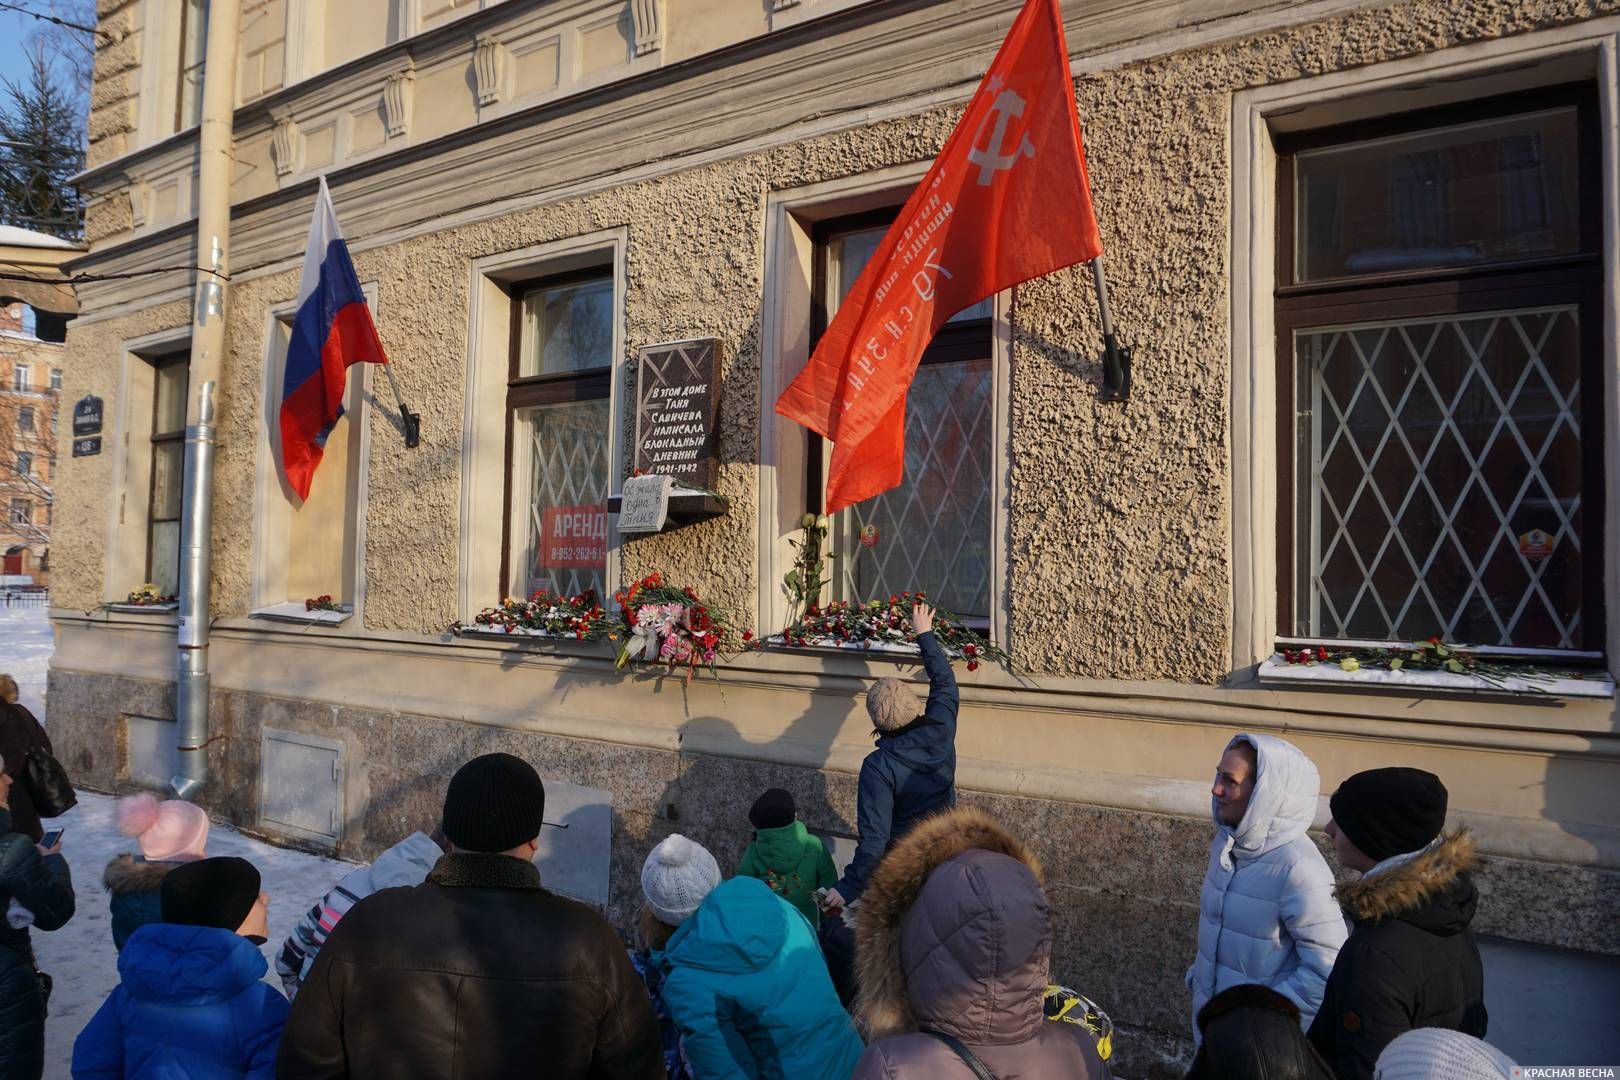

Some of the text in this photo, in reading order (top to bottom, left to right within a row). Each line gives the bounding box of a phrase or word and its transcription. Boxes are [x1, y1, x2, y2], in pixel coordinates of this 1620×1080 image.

[652, 384, 708, 399] В ЭТОМ ДОМЕ
[653, 423, 704, 436] НАПИСАЛА
[644, 434, 706, 450] БЛОКАДНЫЙ
[652, 449, 698, 462] ДНЕВНИК
[655, 463, 698, 474] 1941-1942
[553, 513, 607, 541] АРЕНД
